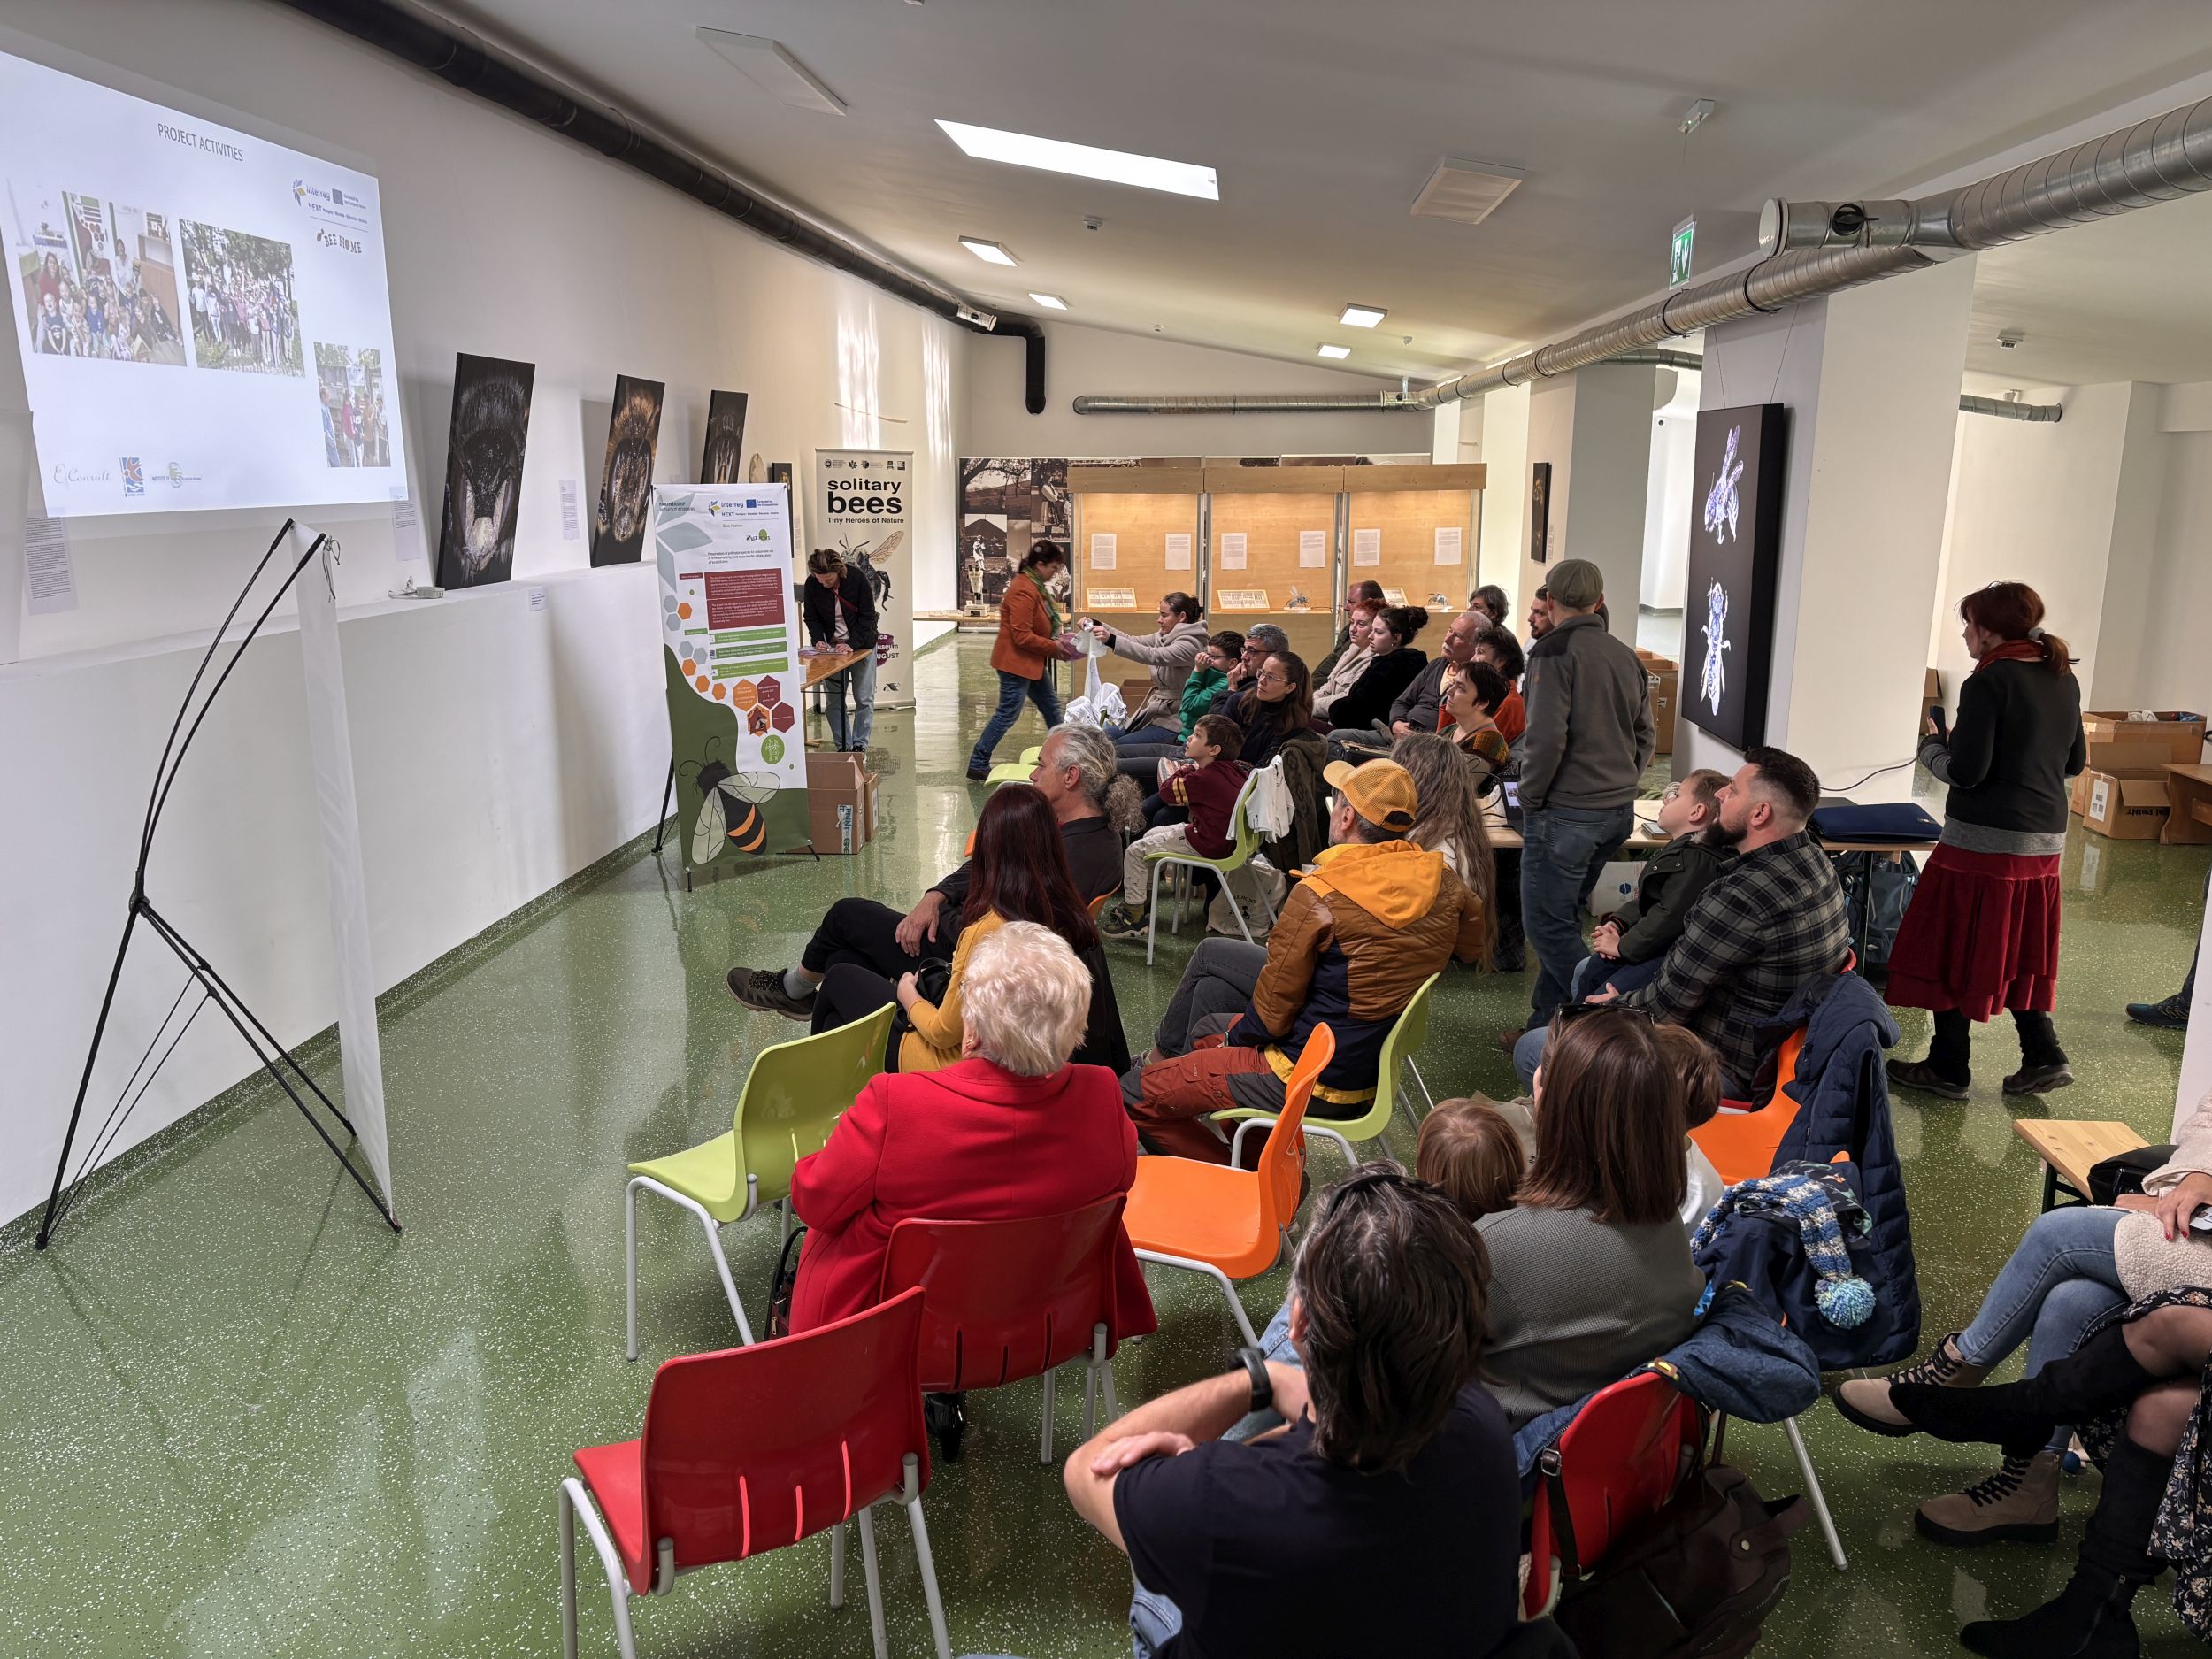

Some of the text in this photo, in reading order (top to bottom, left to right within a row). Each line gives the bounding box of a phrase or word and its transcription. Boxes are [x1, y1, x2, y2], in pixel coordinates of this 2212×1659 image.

[158, 124, 243, 161] PROJECT ACTIVITIES
[324, 234, 362, 254] BEE HOME
[827, 478, 902, 494] solitary
[828, 491, 902, 514] bees
